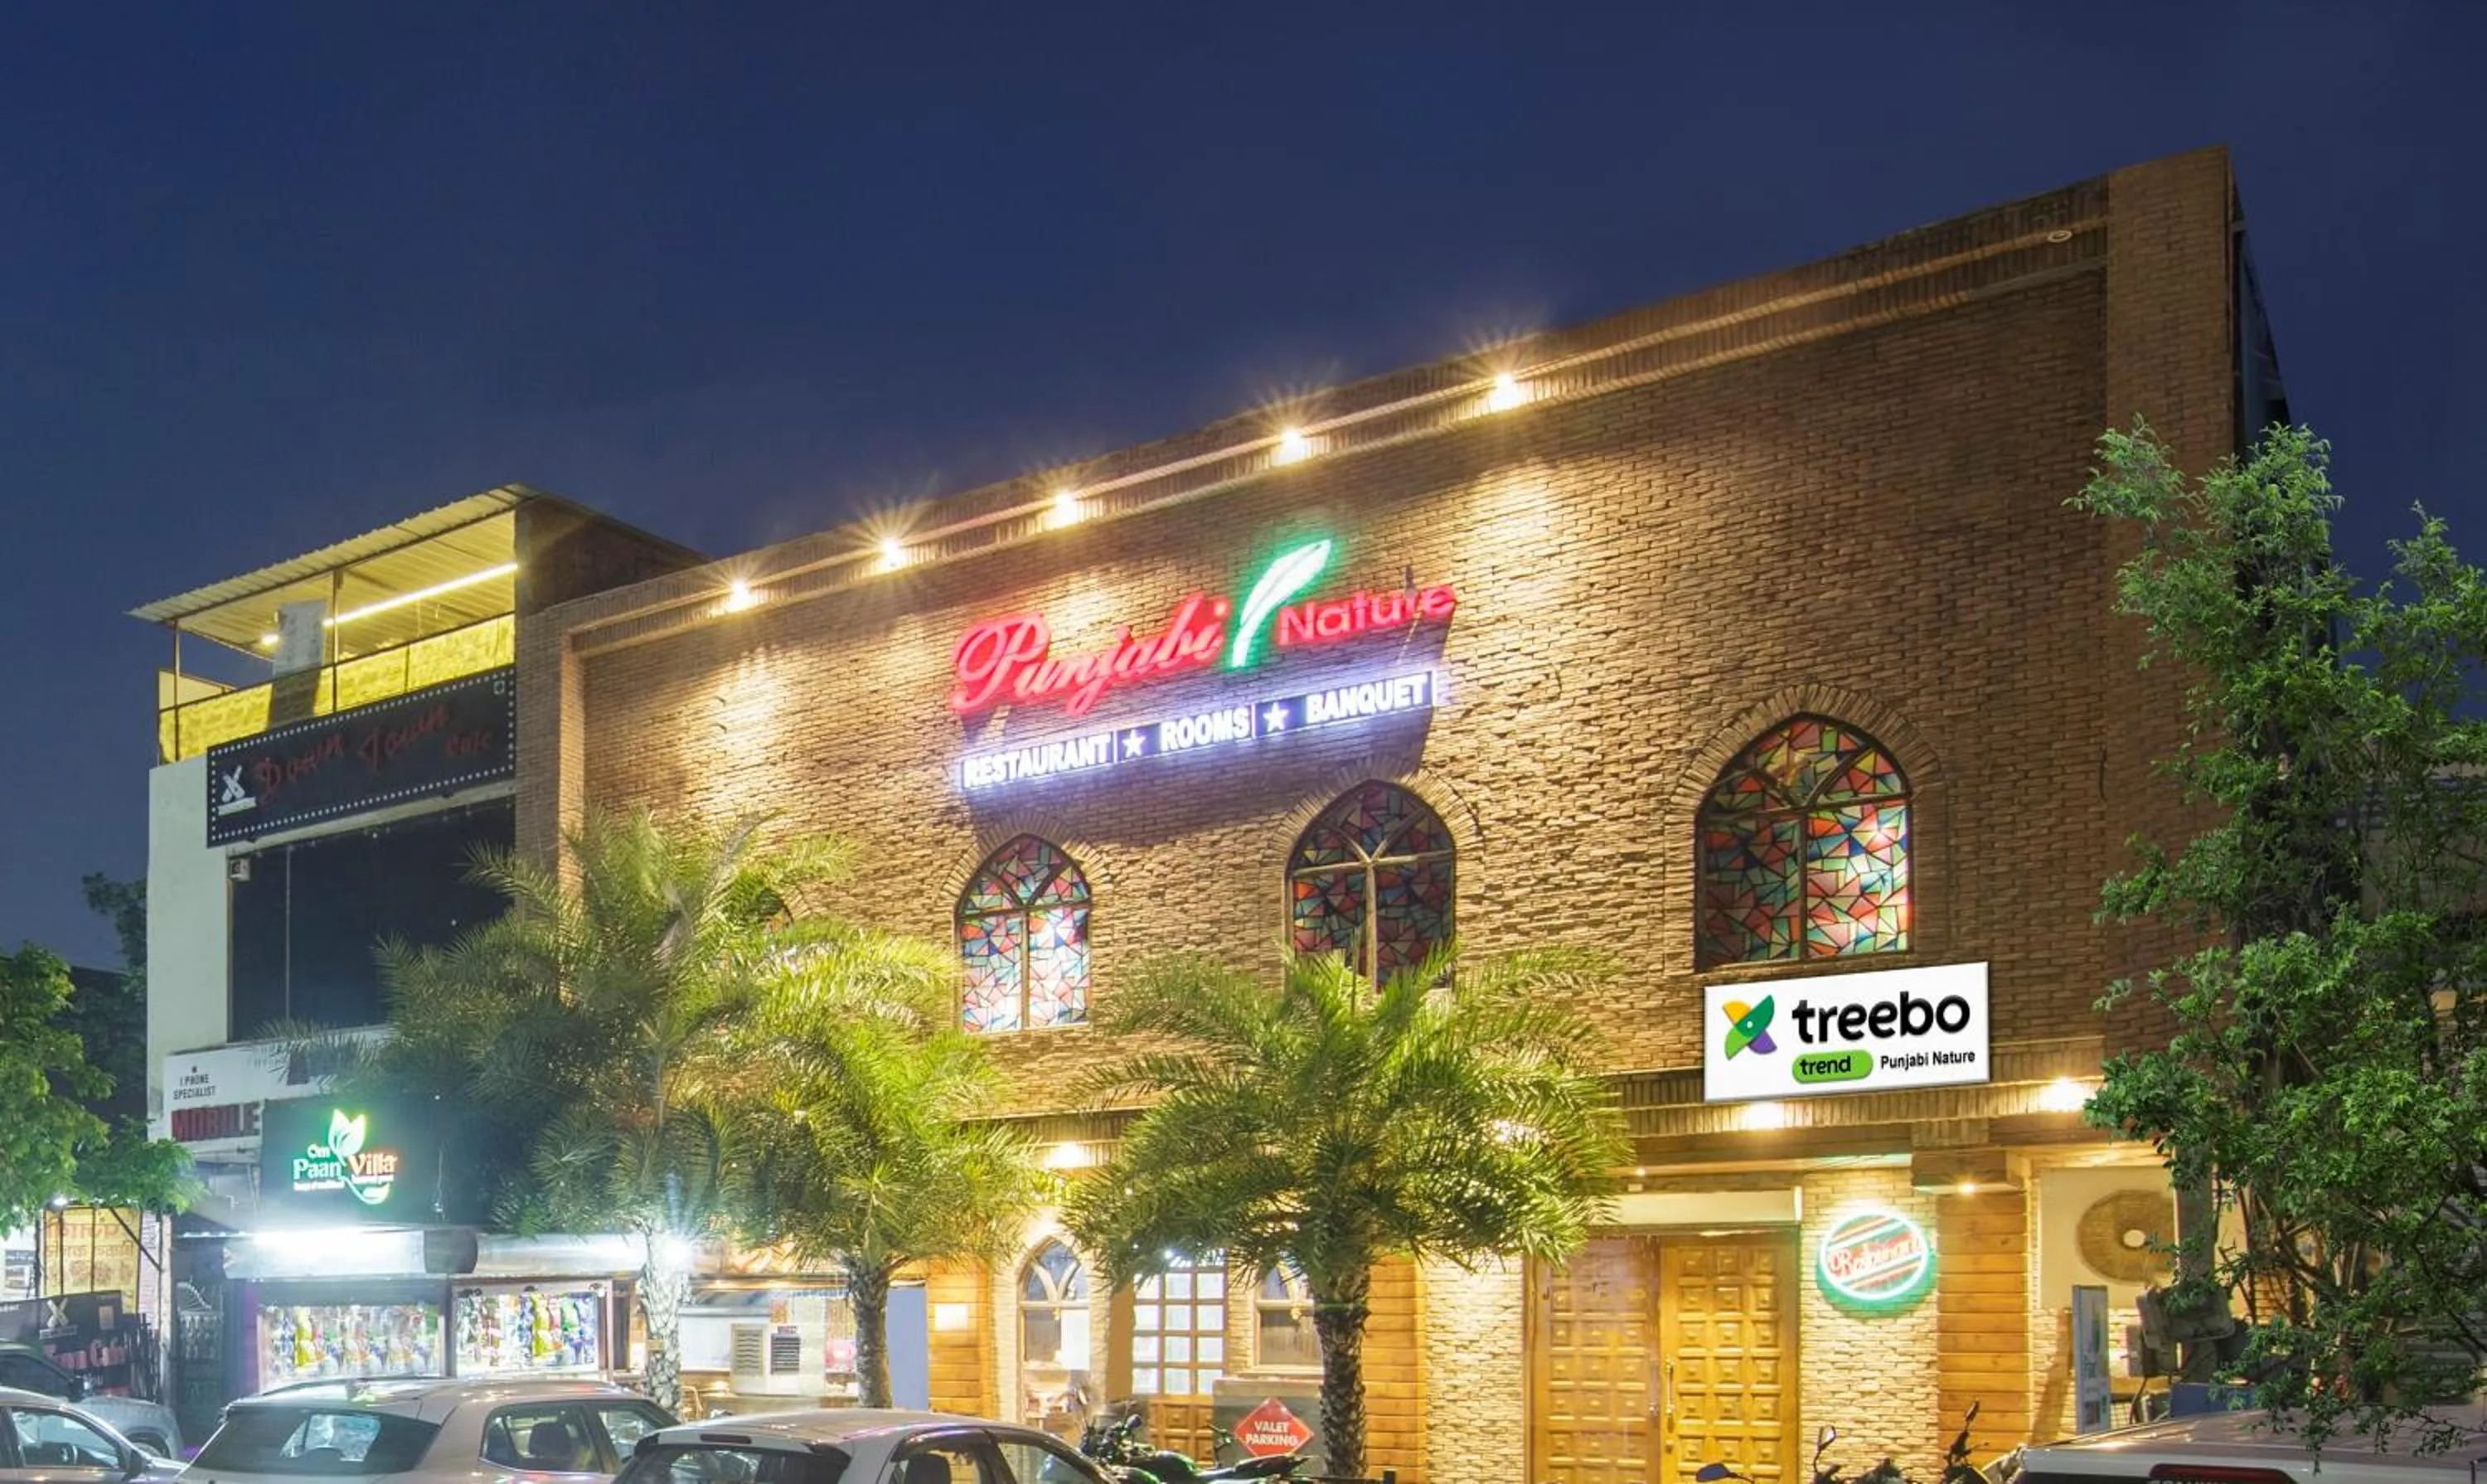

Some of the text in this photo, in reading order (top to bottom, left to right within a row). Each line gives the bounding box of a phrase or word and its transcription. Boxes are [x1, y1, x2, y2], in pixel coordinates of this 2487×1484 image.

[951, 584, 1456, 715] Punjabi Nature
[962, 673, 1428, 788] RESTAURANT ROOMS BANQUET
[1791, 991, 1971, 1044] treebo
[1799, 1050, 1976, 1076] trend Punjabi Nature
[172, 1085, 216, 1100] SPECIALIST
[293, 1153, 397, 1180] Paan Villa
[1254, 1420, 1290, 1433] VALET
[1246, 1433, 1301, 1447] PARKING
